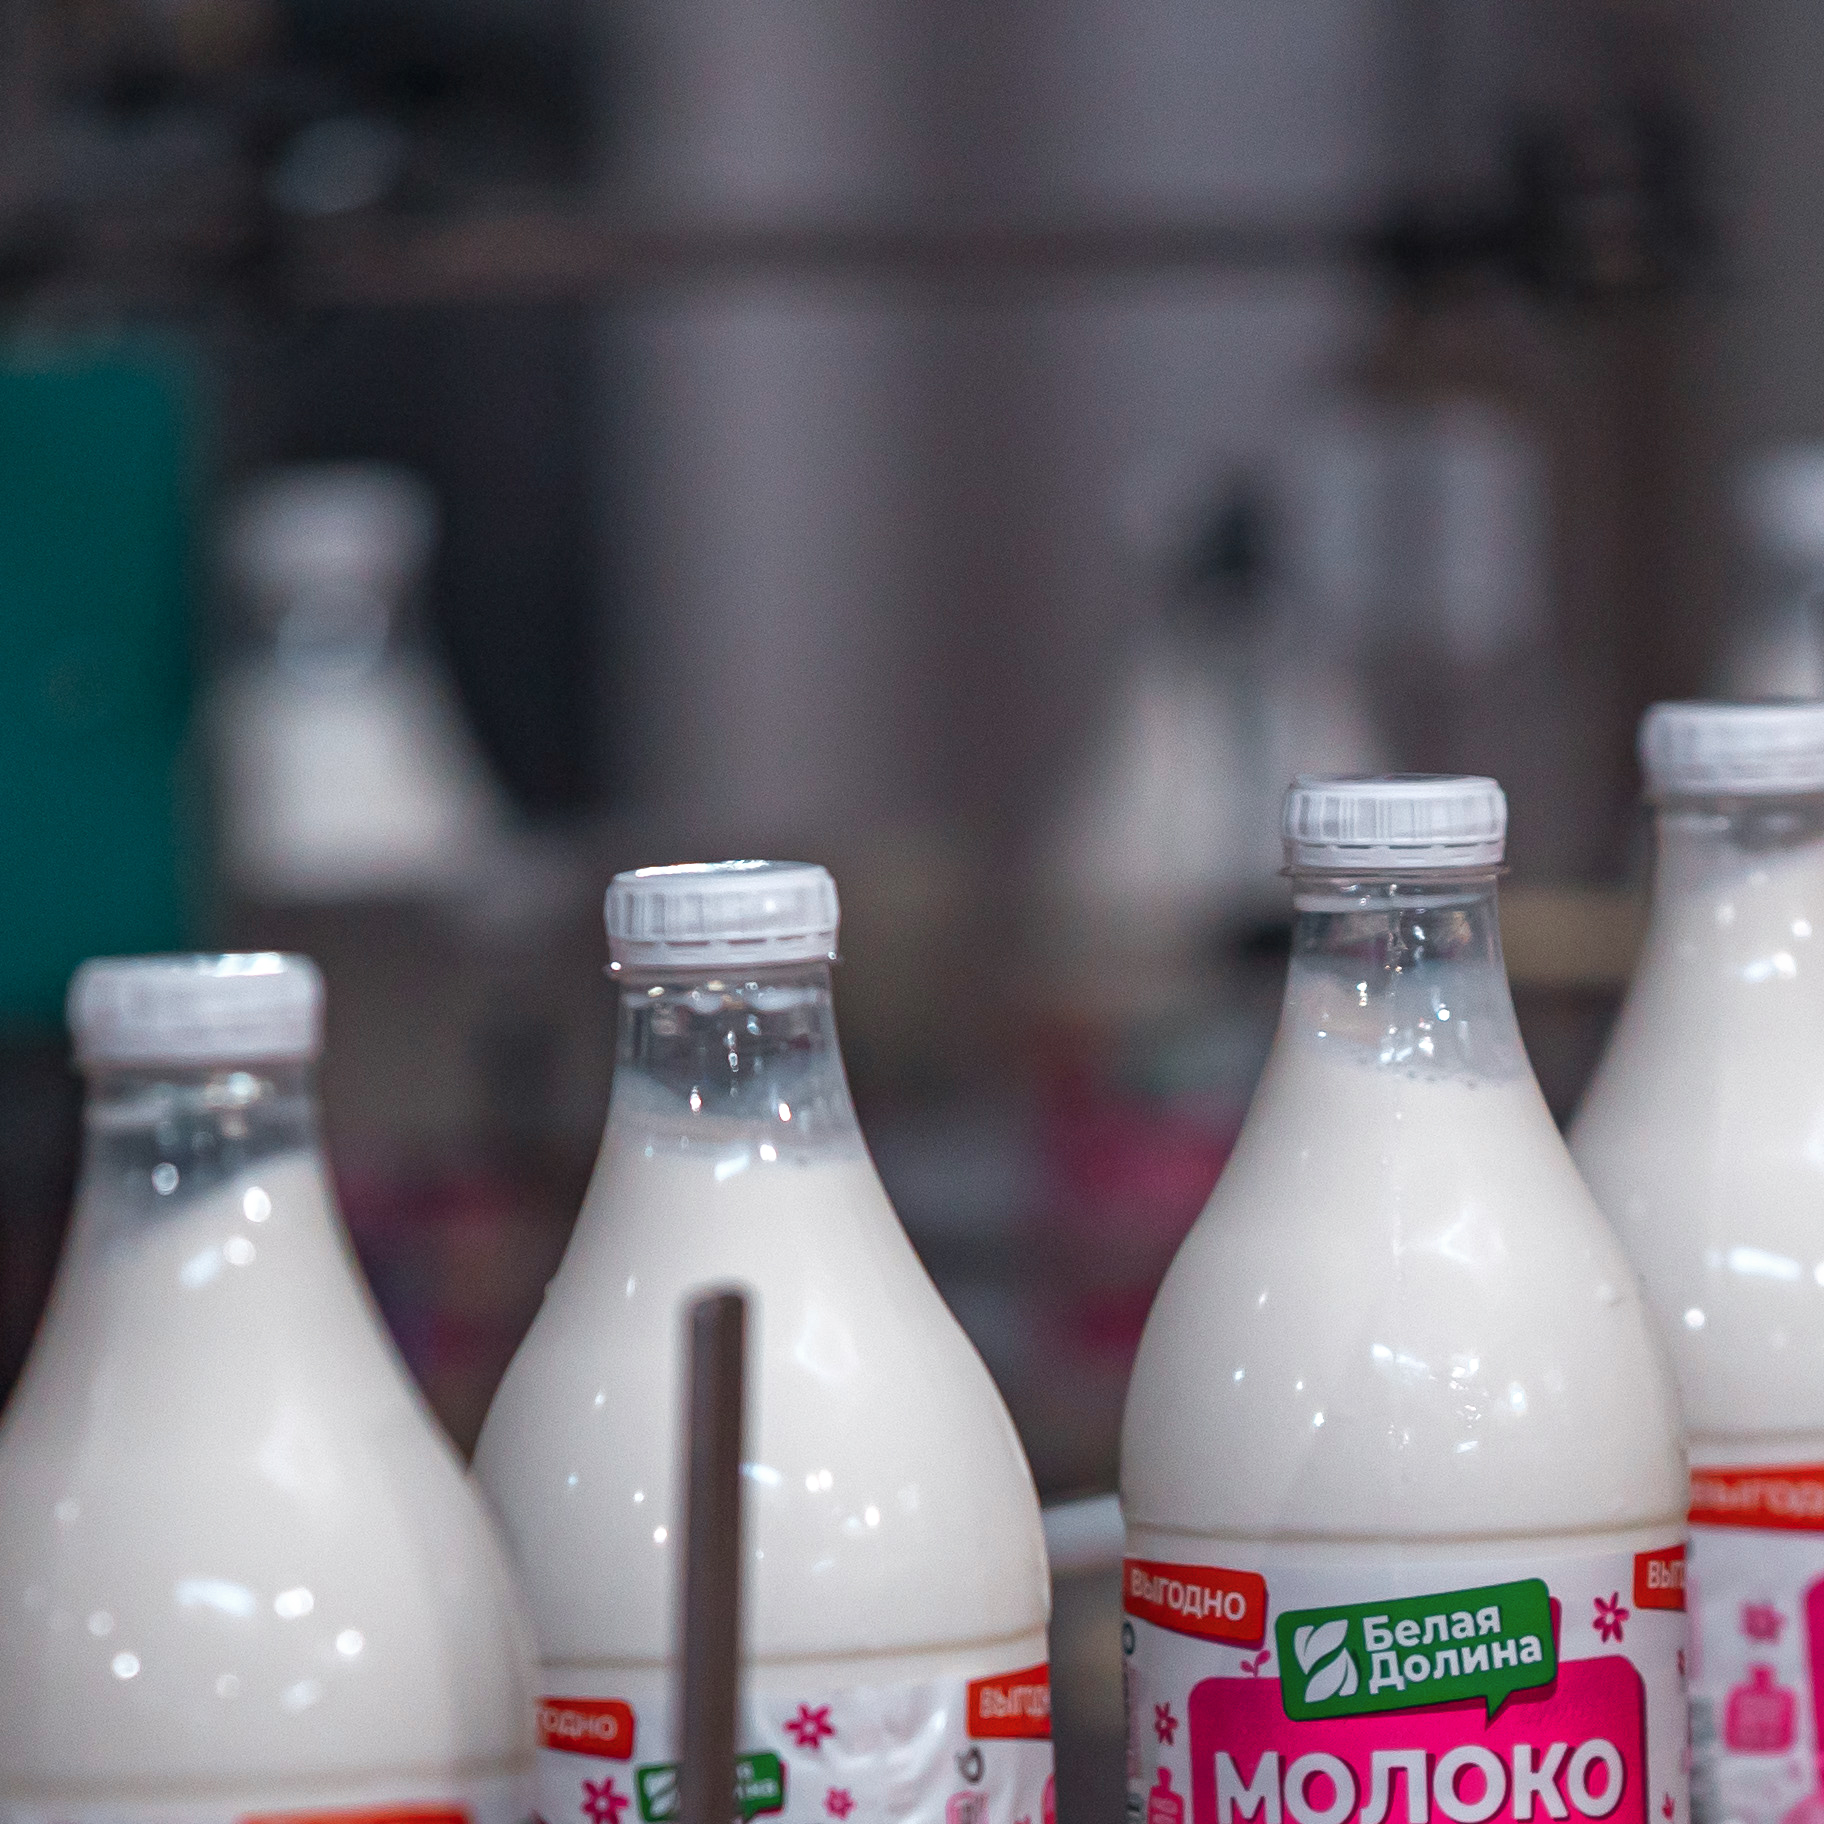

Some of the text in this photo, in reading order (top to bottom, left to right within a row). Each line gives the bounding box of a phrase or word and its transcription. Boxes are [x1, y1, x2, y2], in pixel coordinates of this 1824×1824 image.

[1130, 1568, 1246, 1621] ВЫГОДНО
[1362, 1605, 1502, 1652] Белая
[1369, 1635, 1543, 1695] Долина
